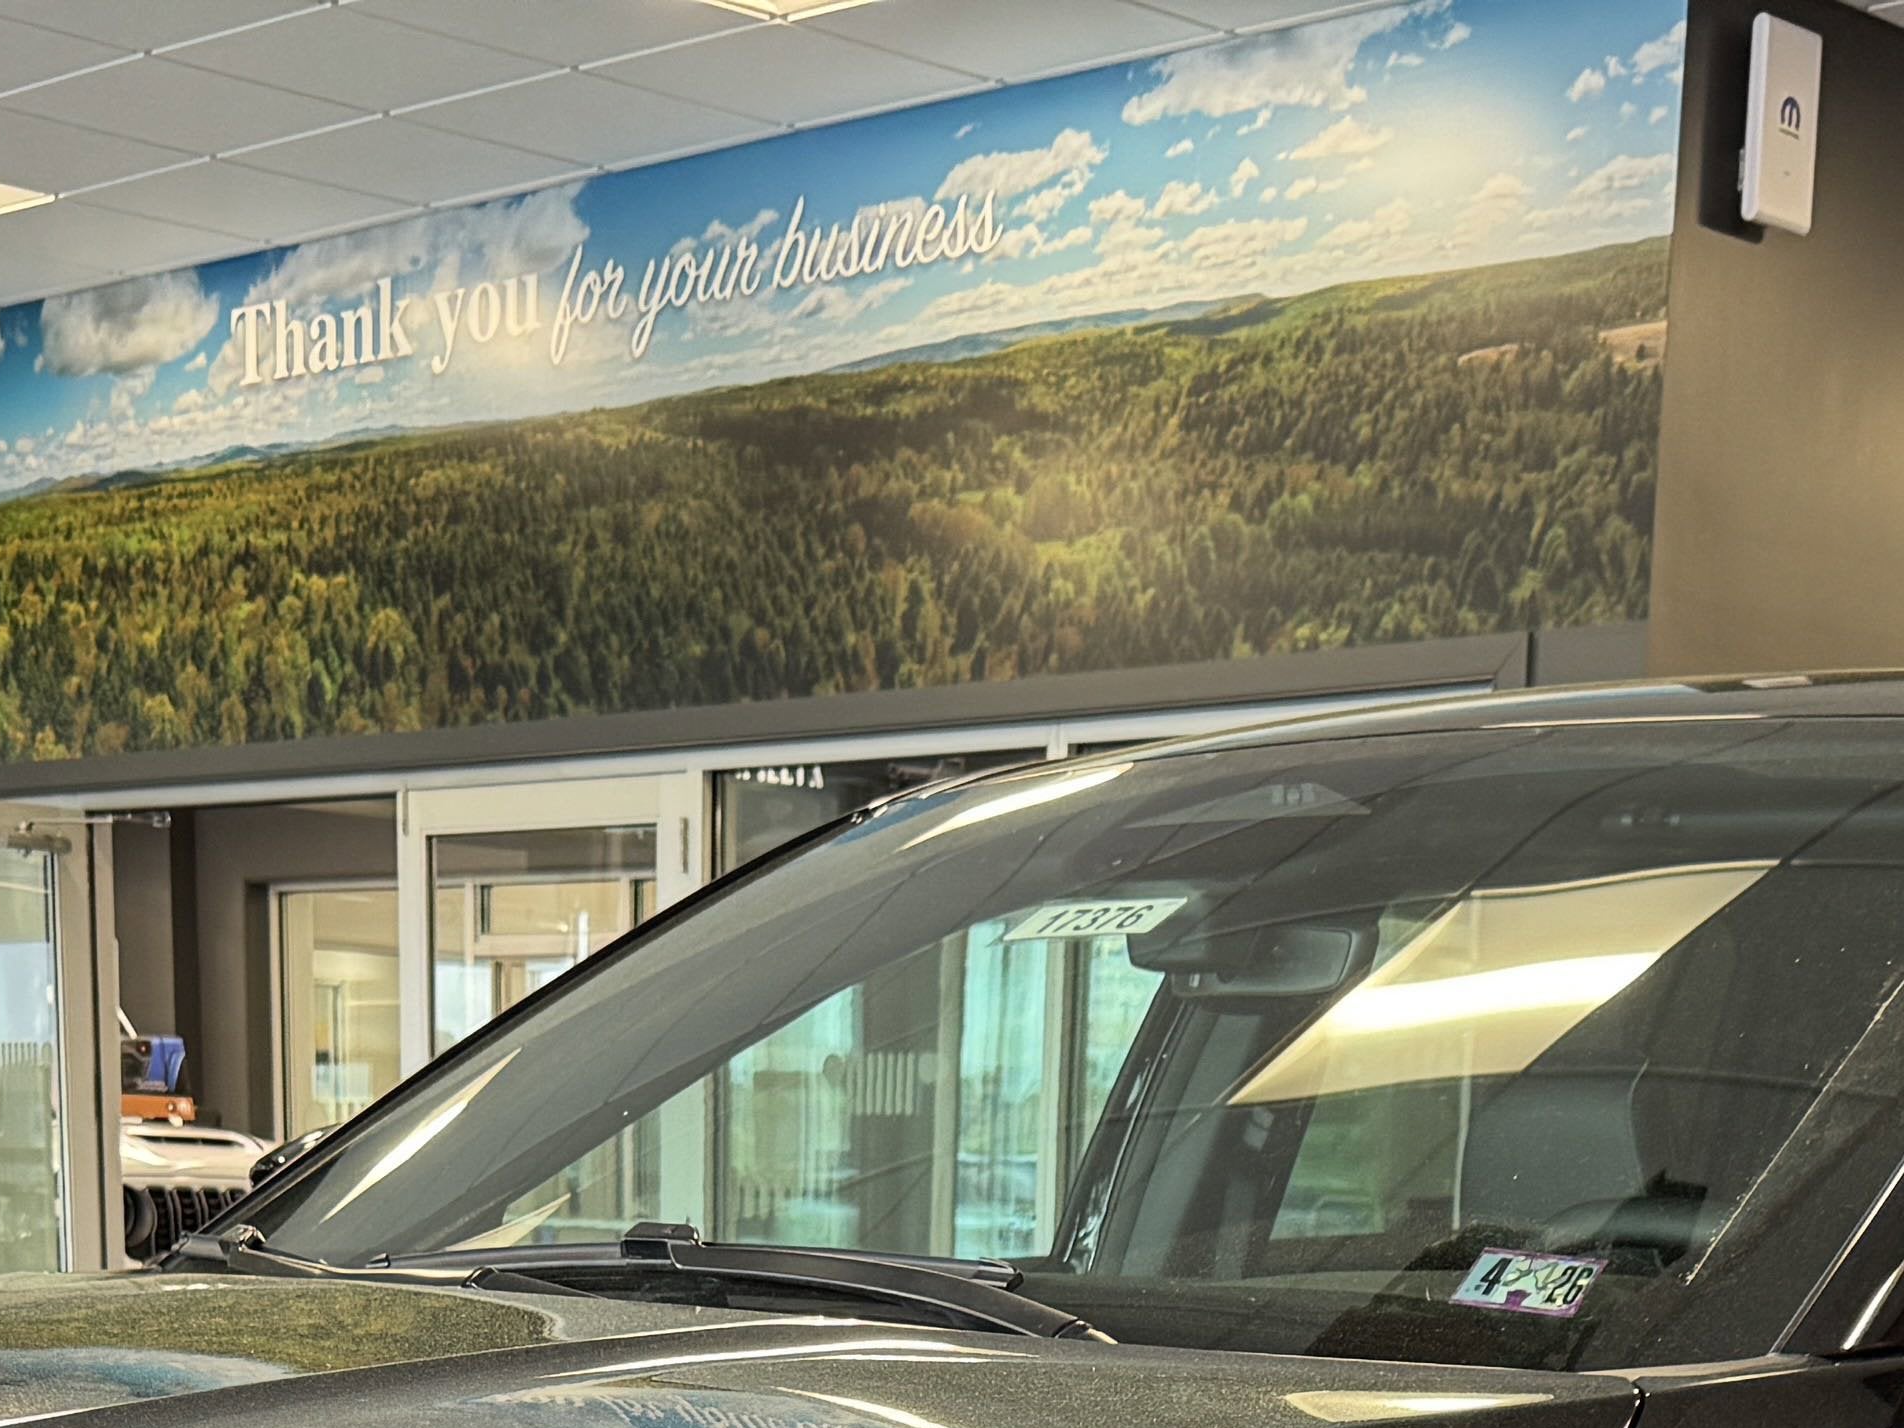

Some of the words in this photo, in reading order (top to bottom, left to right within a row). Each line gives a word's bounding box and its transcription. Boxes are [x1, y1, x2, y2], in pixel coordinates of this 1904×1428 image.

[229, 277, 414, 387] Thank
[435, 271, 542, 375] you
[550, 243, 630, 366] for
[631, 232, 766, 358] your
[770, 191, 1007, 288] business
[1036, 904, 1154, 934] 17376
[1479, 1257, 1514, 1296] 4
[1543, 1264, 1594, 1305] 26
